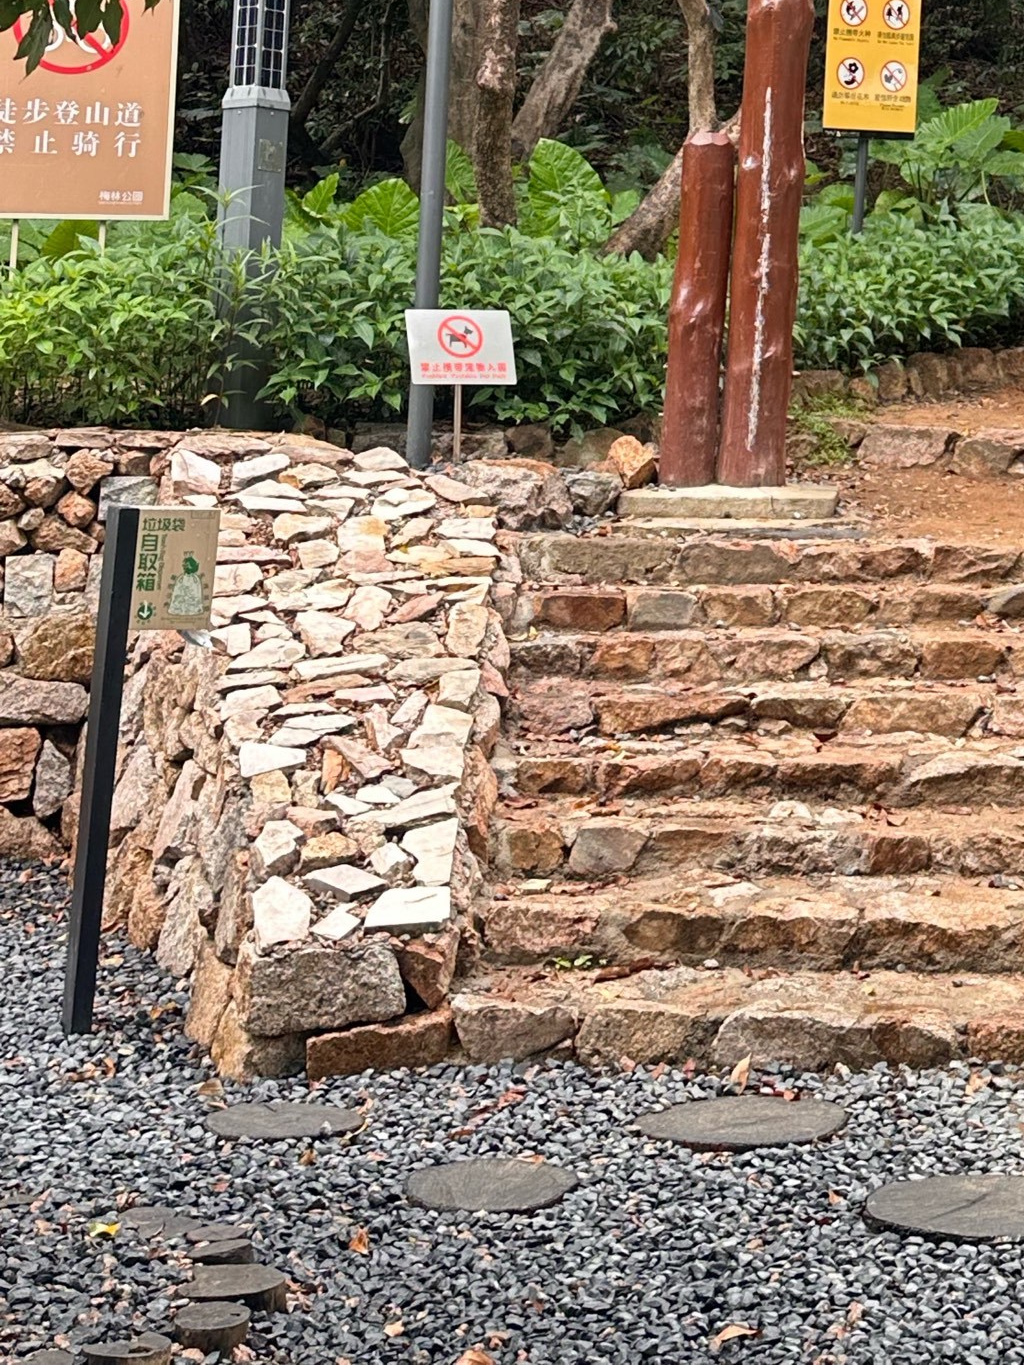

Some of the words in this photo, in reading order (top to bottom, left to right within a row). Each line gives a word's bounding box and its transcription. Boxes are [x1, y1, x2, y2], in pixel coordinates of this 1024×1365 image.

[142, 518, 186, 531] 垃圾袋
[136, 532, 158, 592] 自取箱
